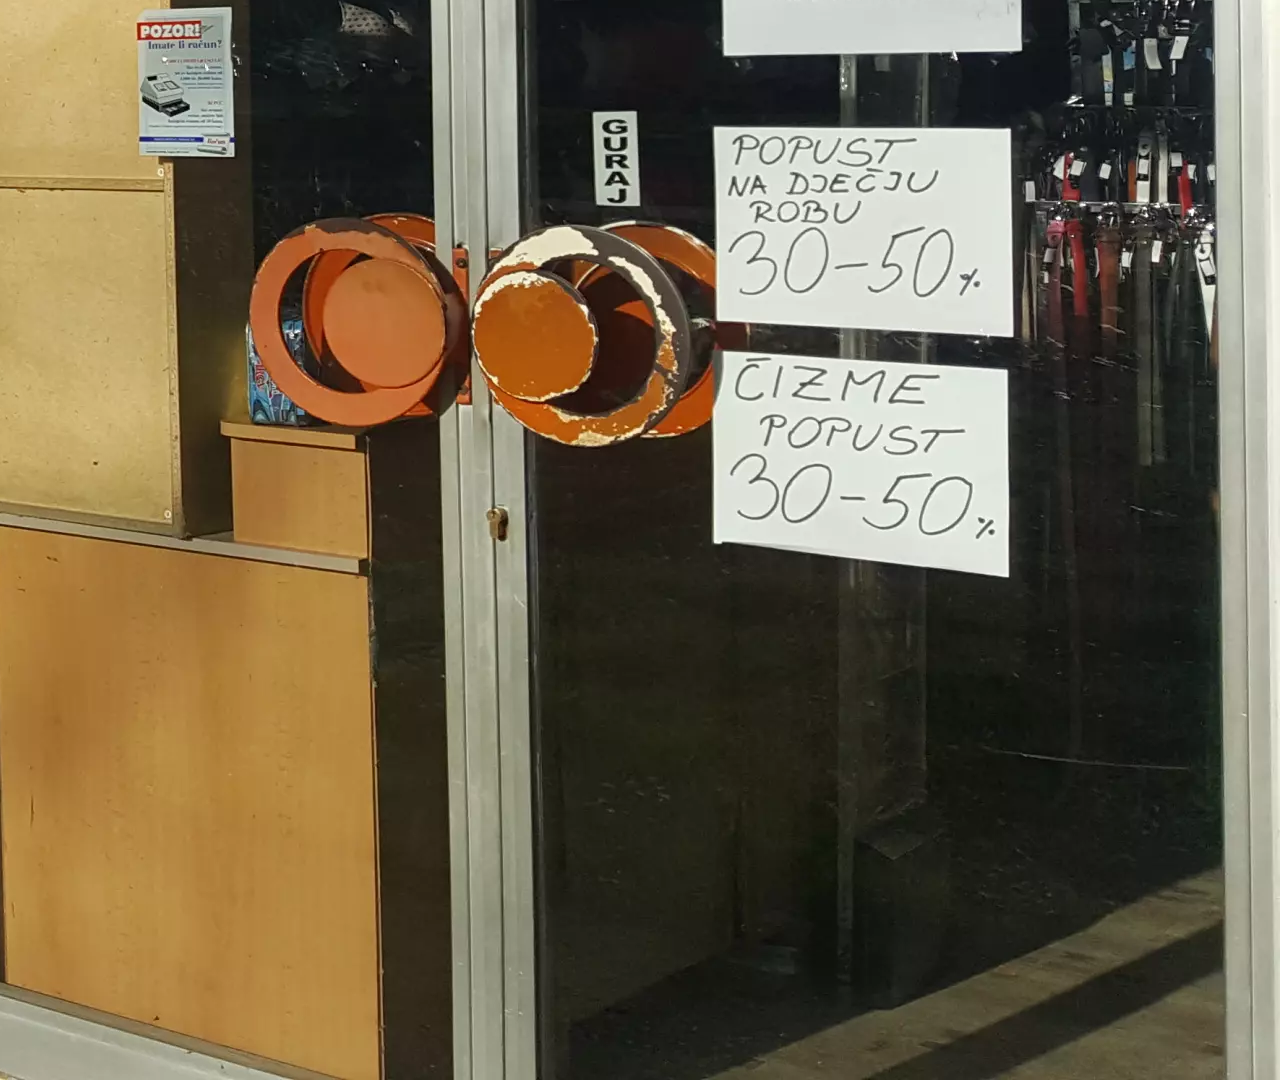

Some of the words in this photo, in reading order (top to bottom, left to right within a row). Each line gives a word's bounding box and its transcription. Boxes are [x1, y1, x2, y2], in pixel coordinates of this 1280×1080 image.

[140, 23, 201, 39] POZOR!
[148, 41, 176, 50] Imate
[602, 119, 631, 204] GURAJ
[731, 134, 917, 167] POPUST
[727, 174, 767, 197] NA
[786, 167, 939, 195] DJEČJU
[749, 200, 862, 224] ROBU
[734, 356, 940, 405] ČIZME
[759, 414, 966, 455] POPUST
